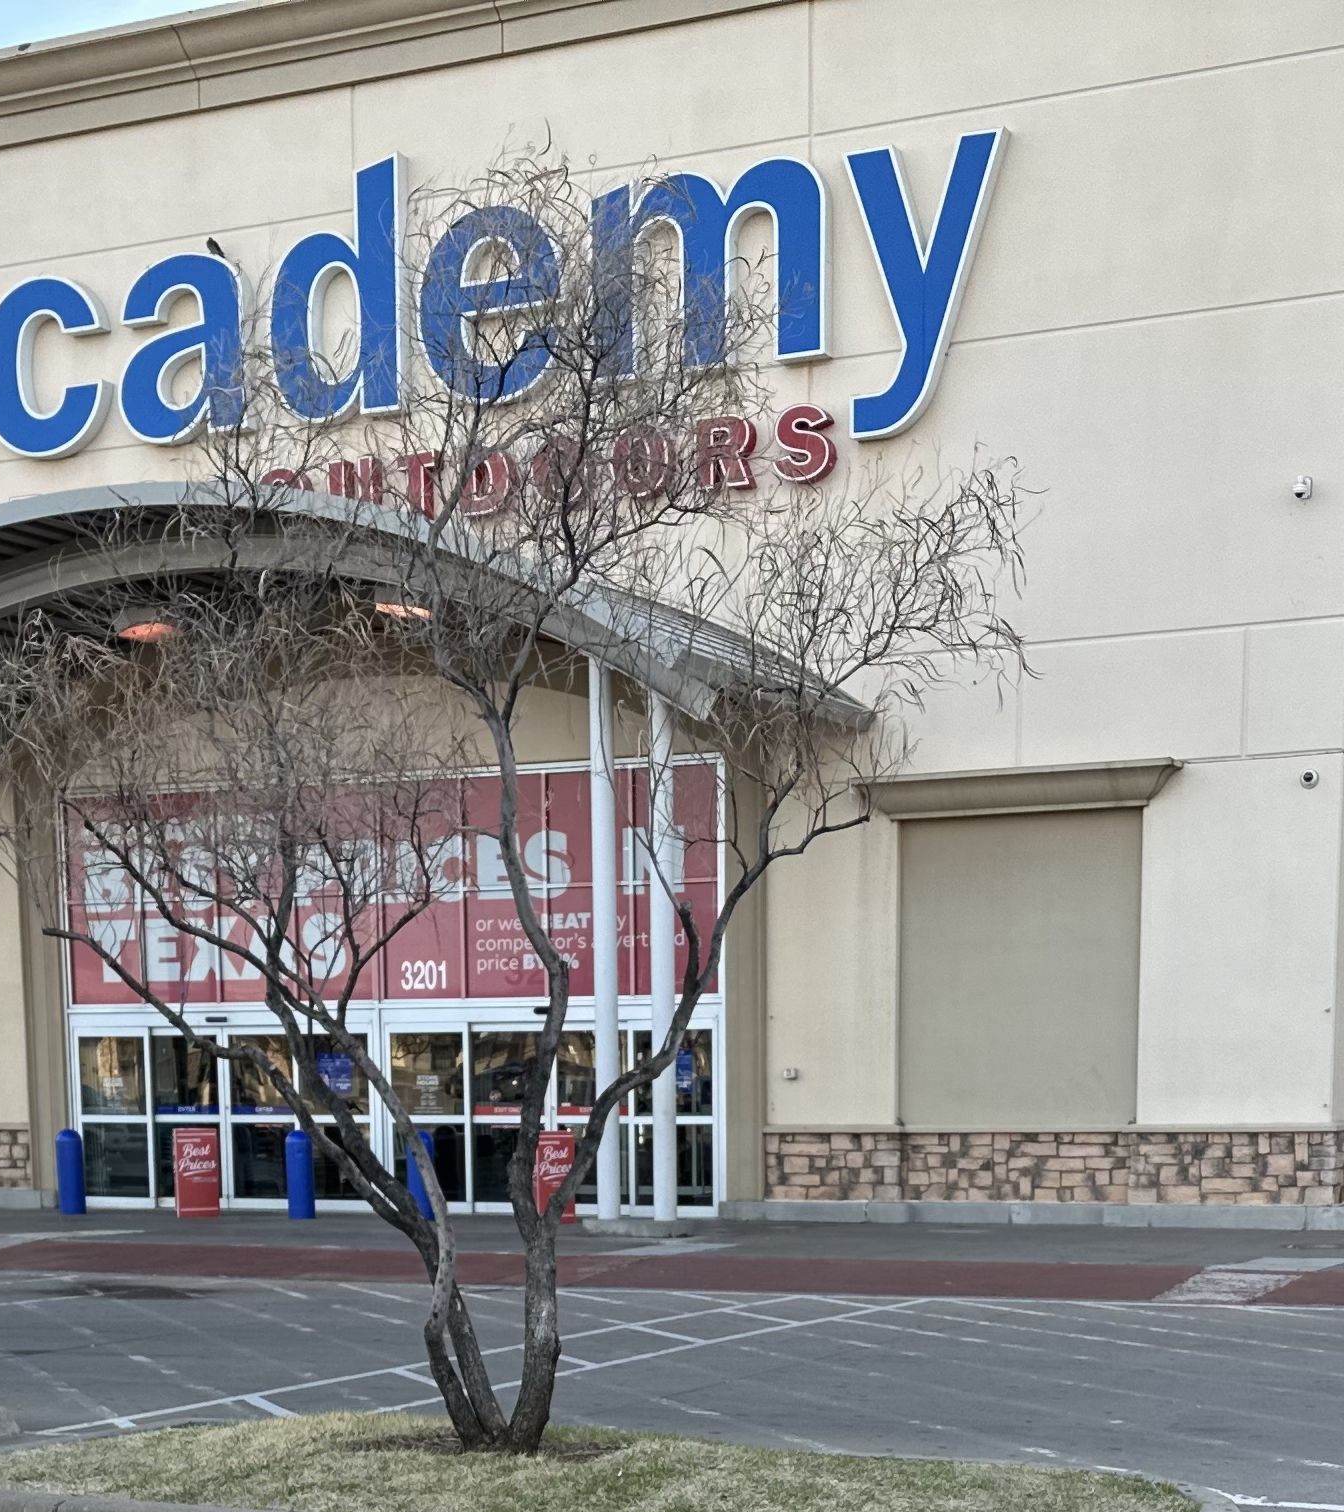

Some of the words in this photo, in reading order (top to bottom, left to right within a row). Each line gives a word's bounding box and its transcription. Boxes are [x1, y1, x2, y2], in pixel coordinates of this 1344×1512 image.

[259, 403, 839, 521] UTDOORS
[475, 918, 494, 932] or
[87, 911, 348, 983] TEXAS
[475, 932, 587, 953] compeor's
[476, 954, 519, 974] price
[400, 959, 448, 990] 3201
[183, 1143, 211, 1159] Best
[543, 1145, 569, 1162] Best
[178, 1158, 217, 1172] Prices
